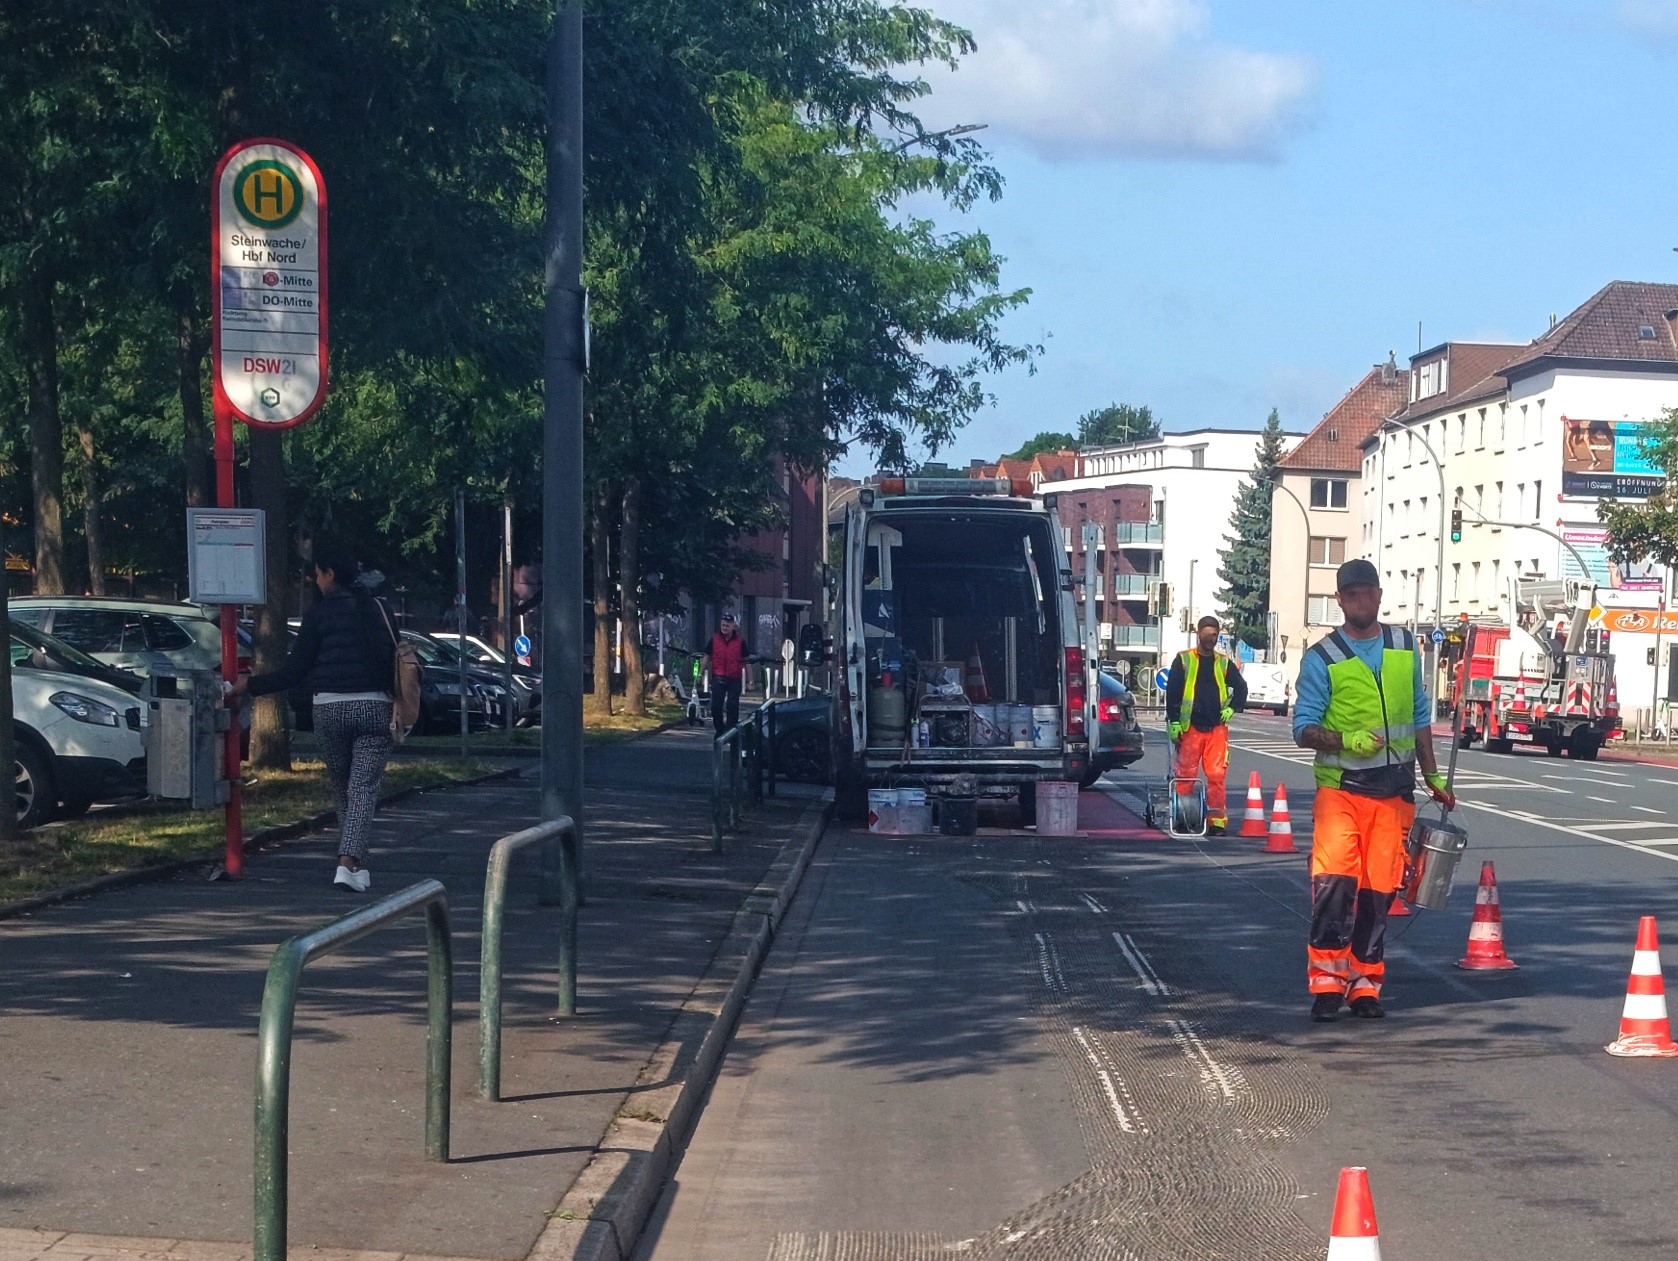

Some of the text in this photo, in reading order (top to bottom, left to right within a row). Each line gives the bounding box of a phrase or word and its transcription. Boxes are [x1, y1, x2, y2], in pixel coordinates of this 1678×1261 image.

[254, 174, 283, 215] H
[231, 234, 306, 249] Steinwache/
[242, 250, 297, 264] Hbf Nord
[262, 274, 313, 287] -Mitte
[262, 295, 314, 308] DO-Mitte
[243, 357, 297, 375] DSW21
[1632, 487, 1652, 495] JULI
